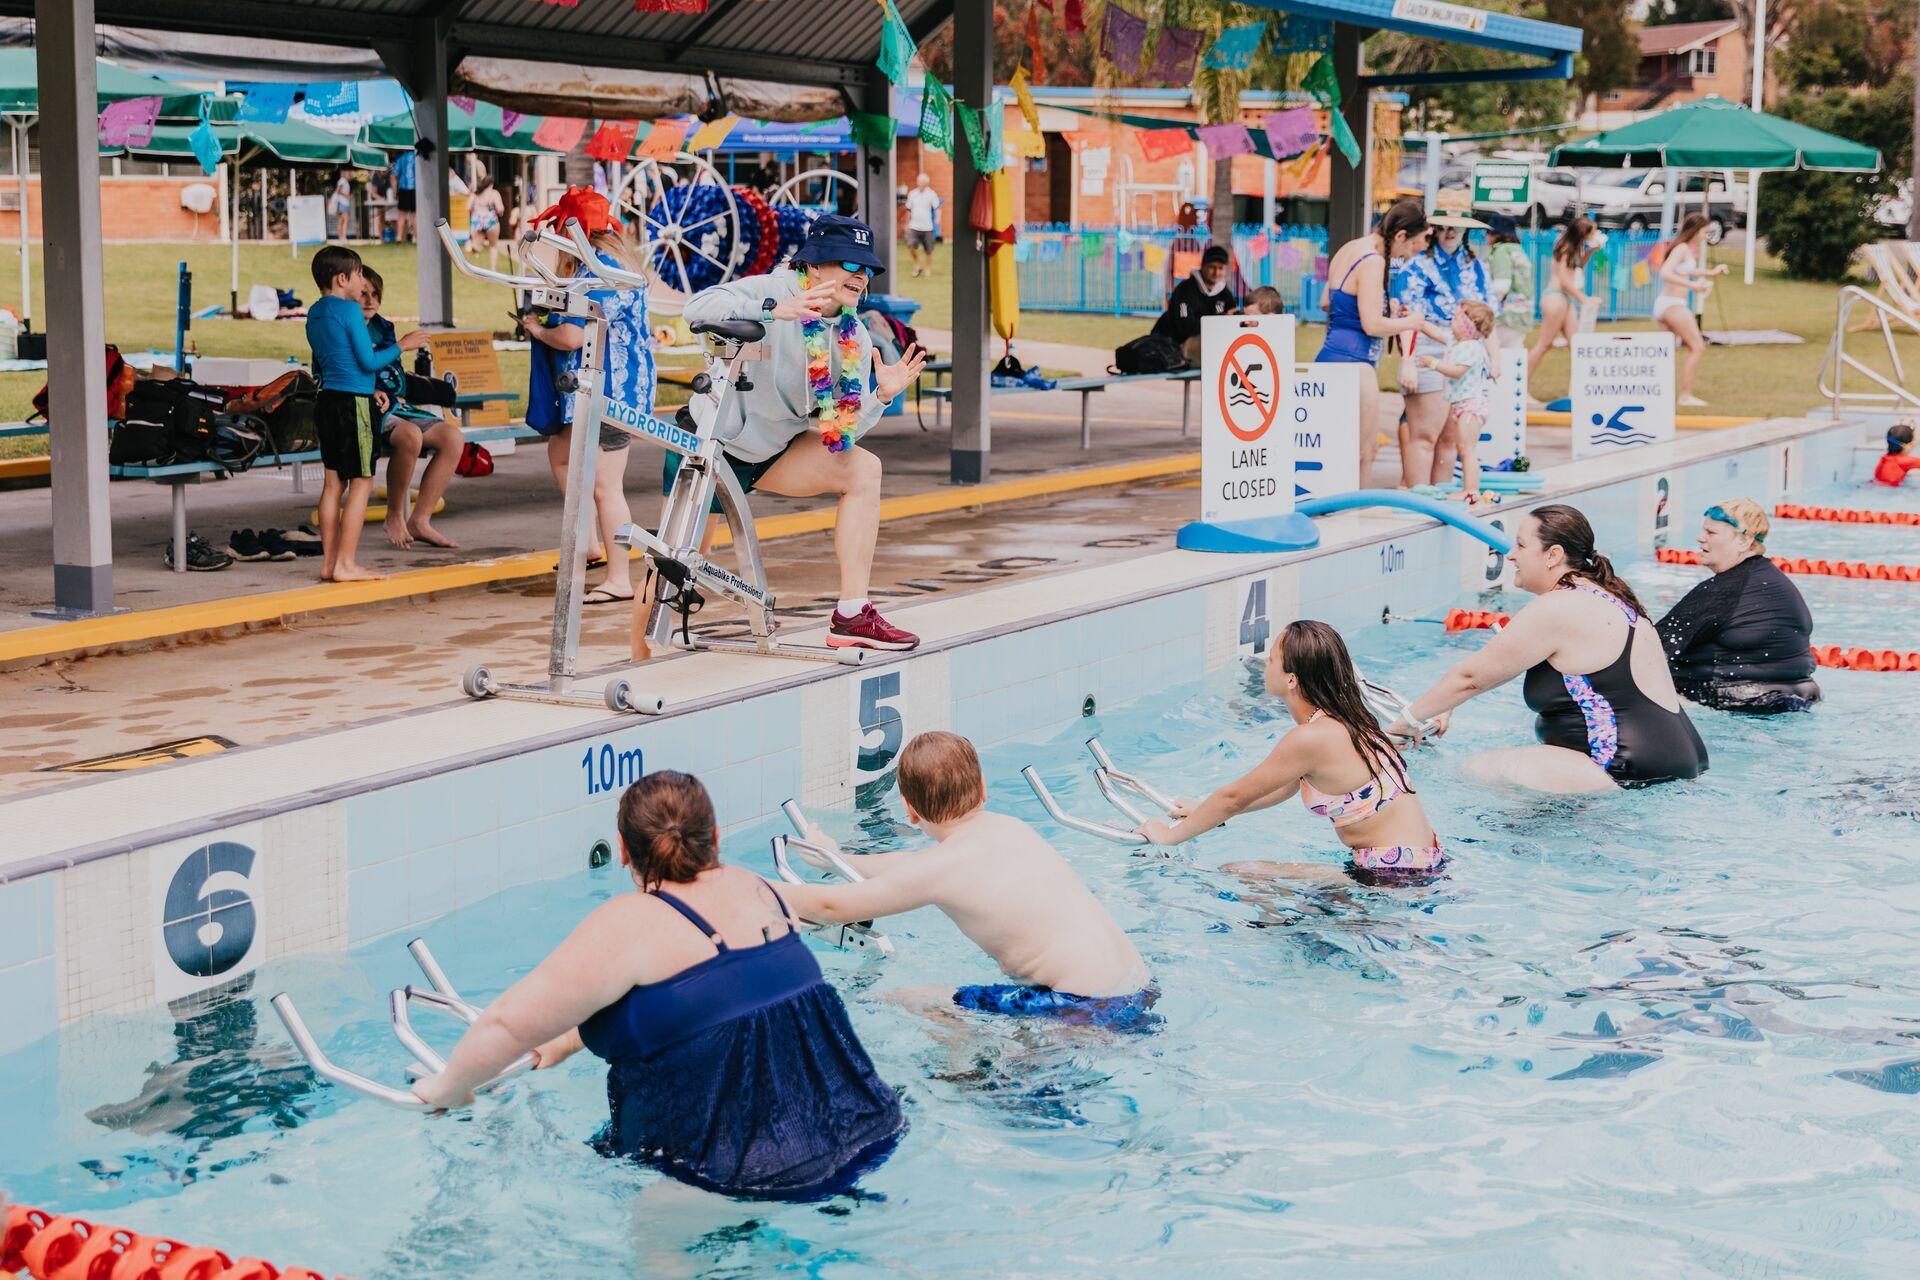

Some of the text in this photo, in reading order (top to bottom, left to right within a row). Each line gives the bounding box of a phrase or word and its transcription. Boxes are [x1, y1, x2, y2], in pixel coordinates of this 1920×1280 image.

[1577, 346, 1668, 359] RECREATION
[1590, 366, 1656, 377] & LEISURE
[1584, 384, 1662, 396] SWIMMING
[606, 400, 698, 453] HYDRORIDER
[1232, 447, 1267, 469] LANE
[1222, 478, 1276, 501] CLOSED
[1655, 477, 1669, 530] 2
[1380, 544, 1405, 575] 1.0m
[703, 562, 764, 600] Aquabike Professional
[1239, 578, 1271, 654] 4
[856, 671, 903, 772] 5
[582, 743, 644, 795] 1.0m
[163, 841, 257, 977] 6
